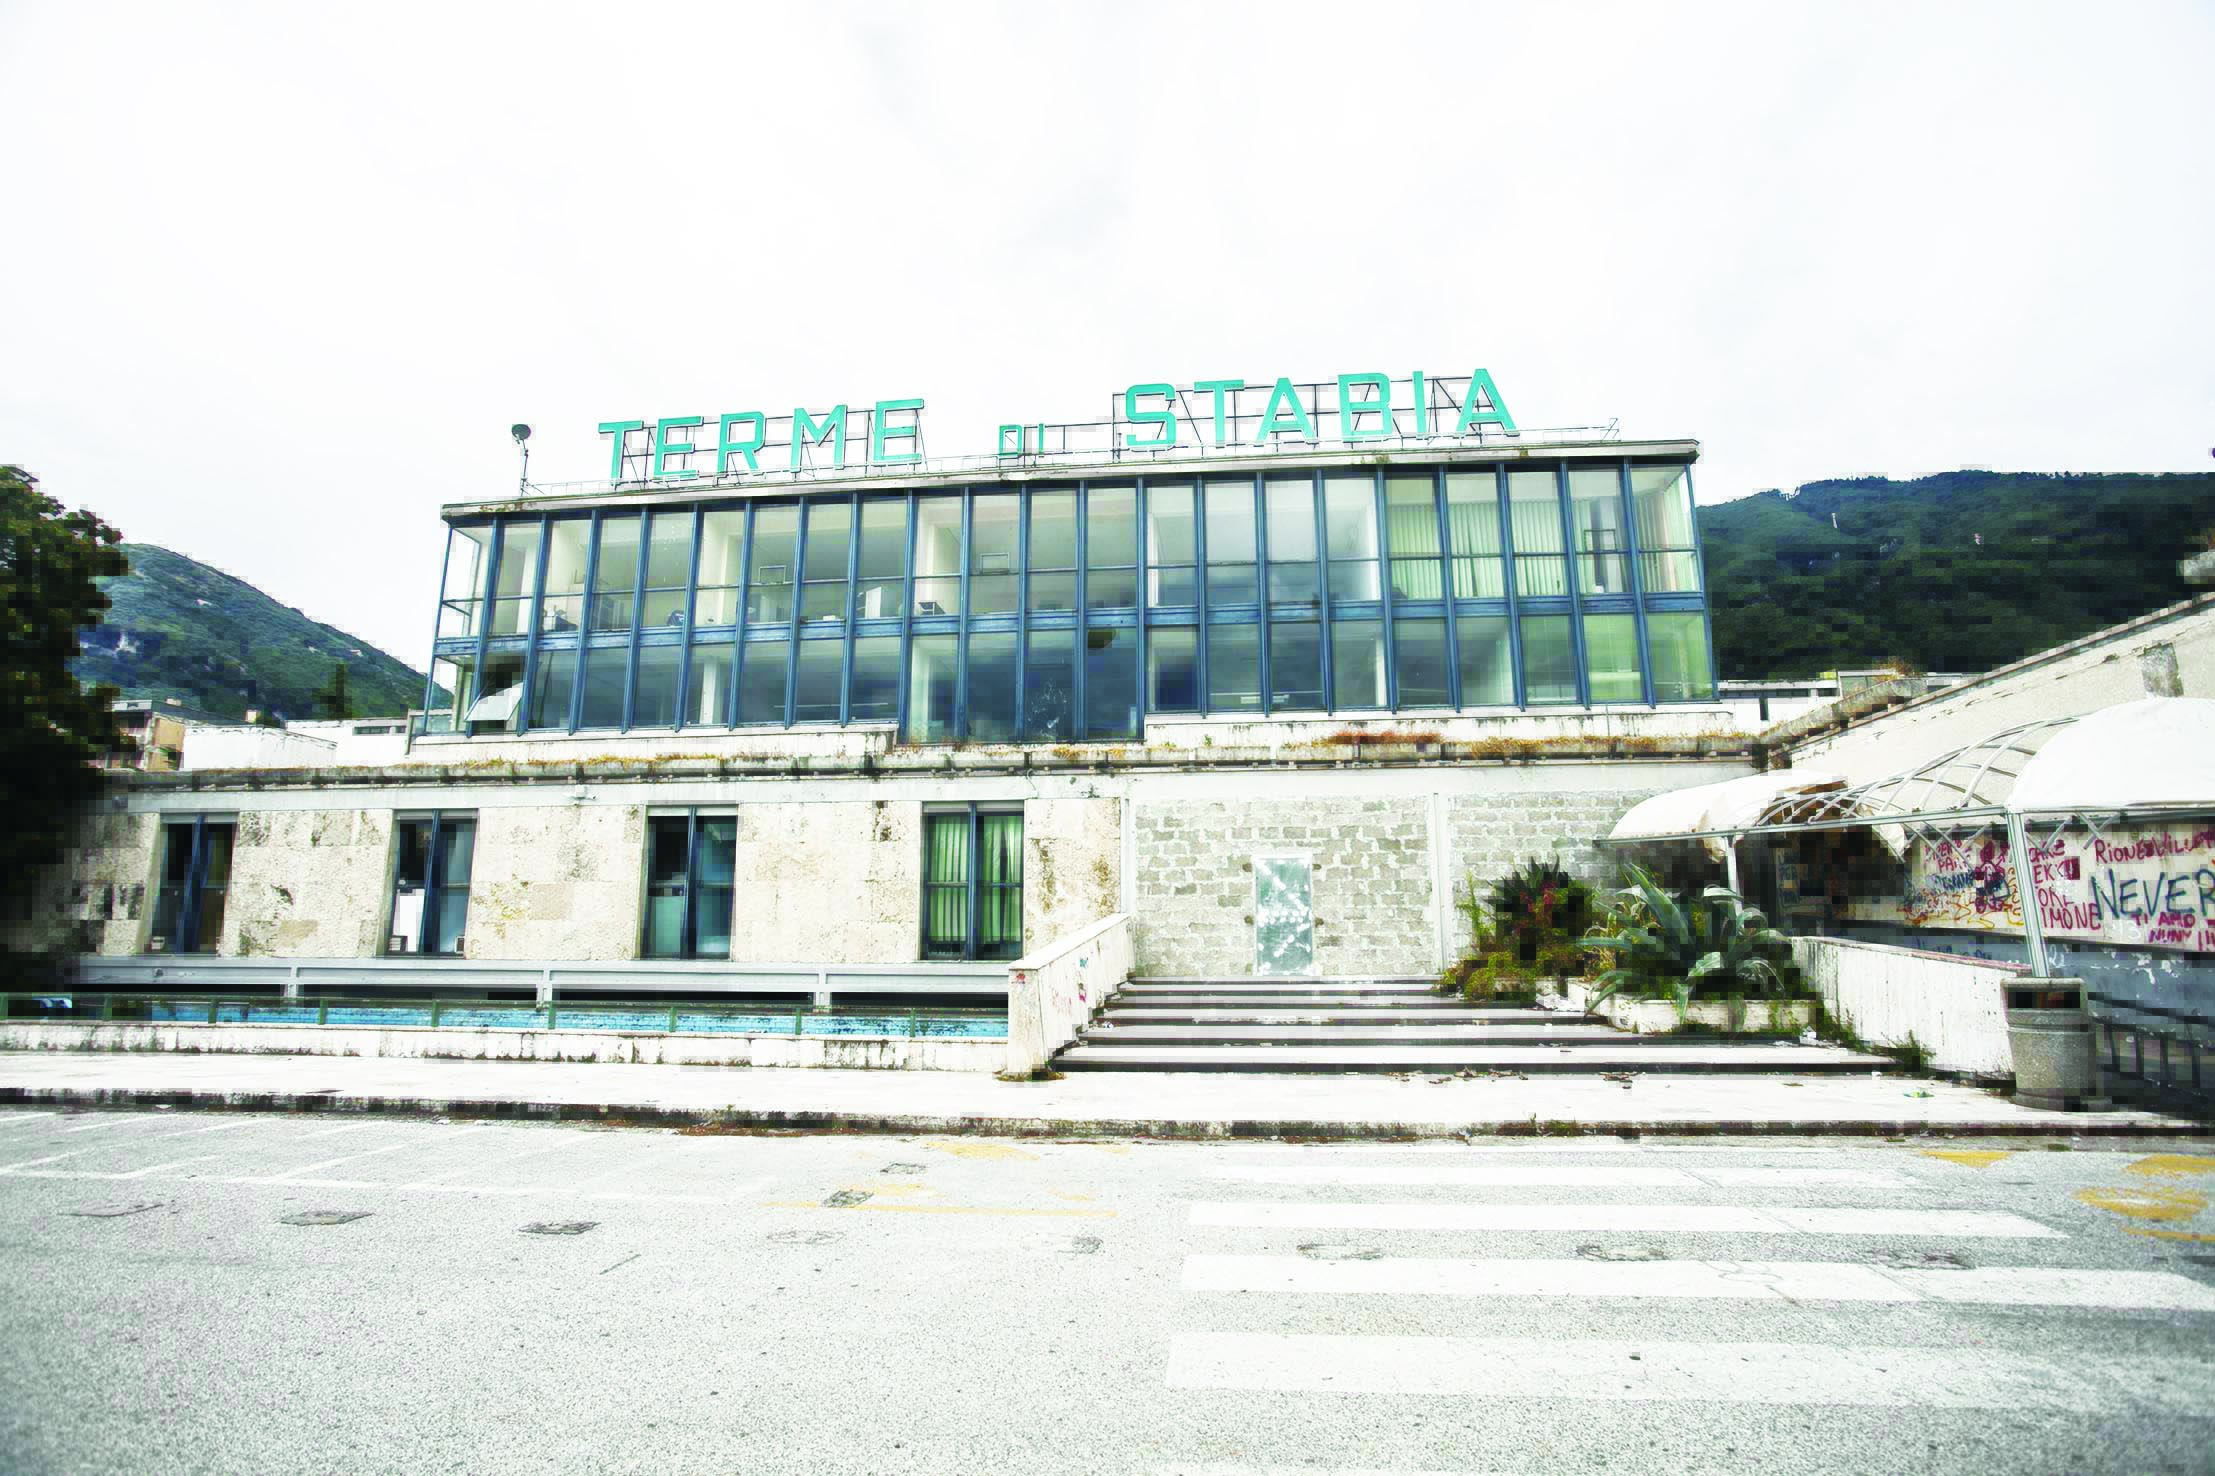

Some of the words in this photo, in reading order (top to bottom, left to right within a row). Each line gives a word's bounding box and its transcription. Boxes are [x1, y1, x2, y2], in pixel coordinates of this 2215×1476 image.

[598, 397, 924, 488] TERME
[999, 423, 1044, 456] DI
[1124, 367, 1521, 450] STABIA
